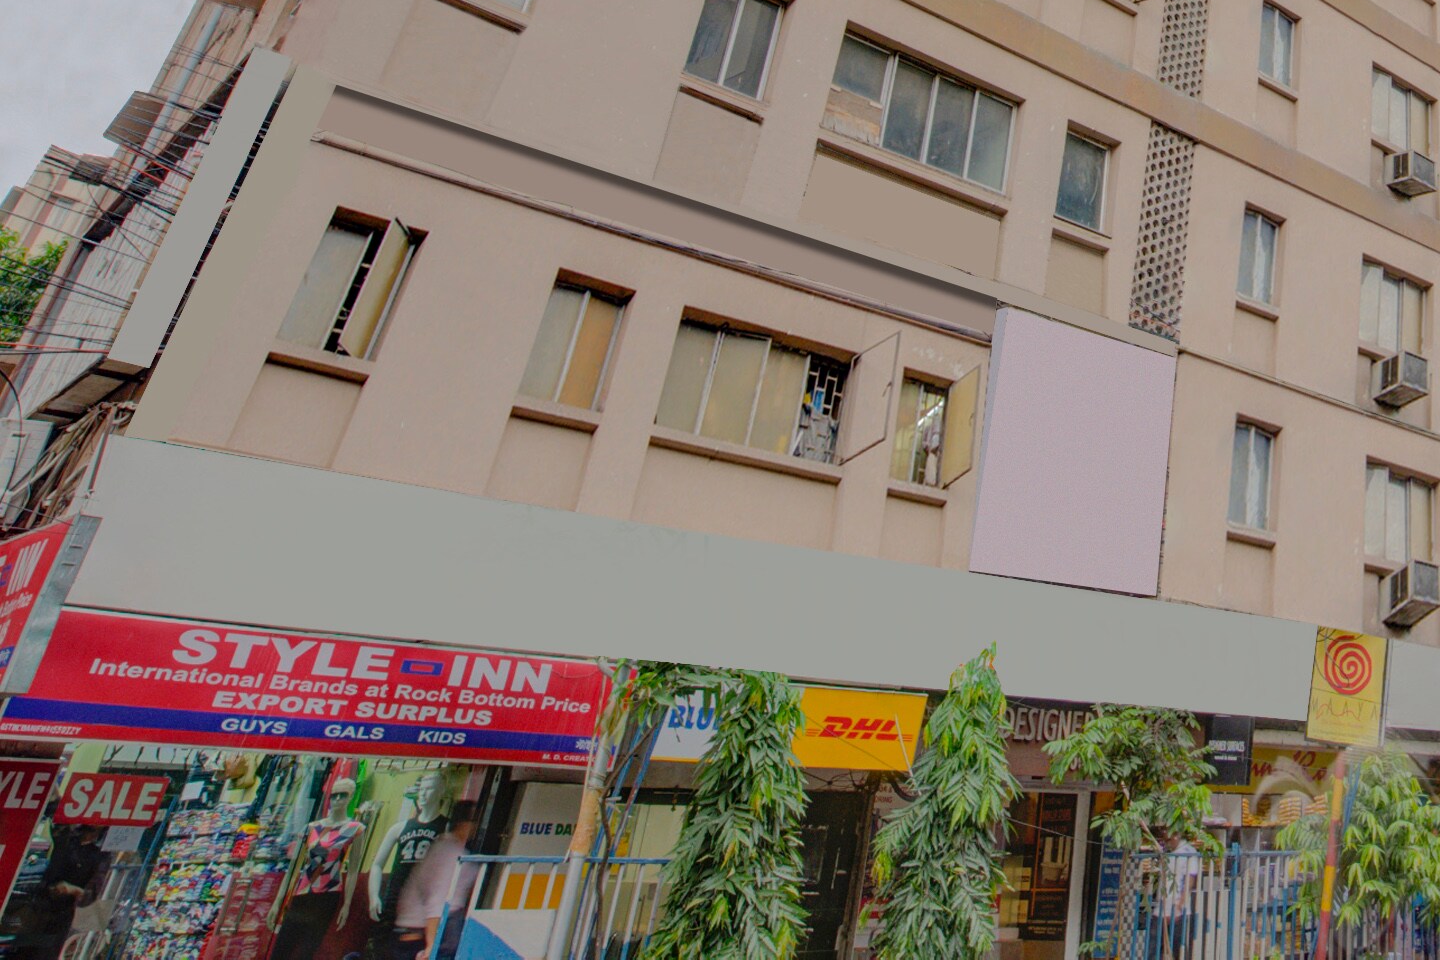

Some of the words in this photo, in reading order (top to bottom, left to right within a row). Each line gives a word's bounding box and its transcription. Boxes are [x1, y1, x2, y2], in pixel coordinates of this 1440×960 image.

[172, 629, 394, 681] STYLE
[447, 654, 552, 694] INN
[88, 658, 263, 688] International
[269, 674, 358, 696] Brands
[364, 684, 389, 699] at
[394, 684, 454, 703] Rock
[458, 692, 536, 710] Bottom
[541, 696, 591, 714] Price
[212, 691, 349, 716] EXPORT
[354, 701, 493, 726] SURPLUS
[667, 705, 721, 730] BLU
[220, 718, 288, 734] GUYS
[324, 724, 384, 740] GALS
[418, 730, 467, 744] KIDS
[818, 716, 900, 742] DHL
[63, 778, 164, 821] SALE
[520, 822, 553, 835] BLUE
[554, 823, 578, 836] DA
